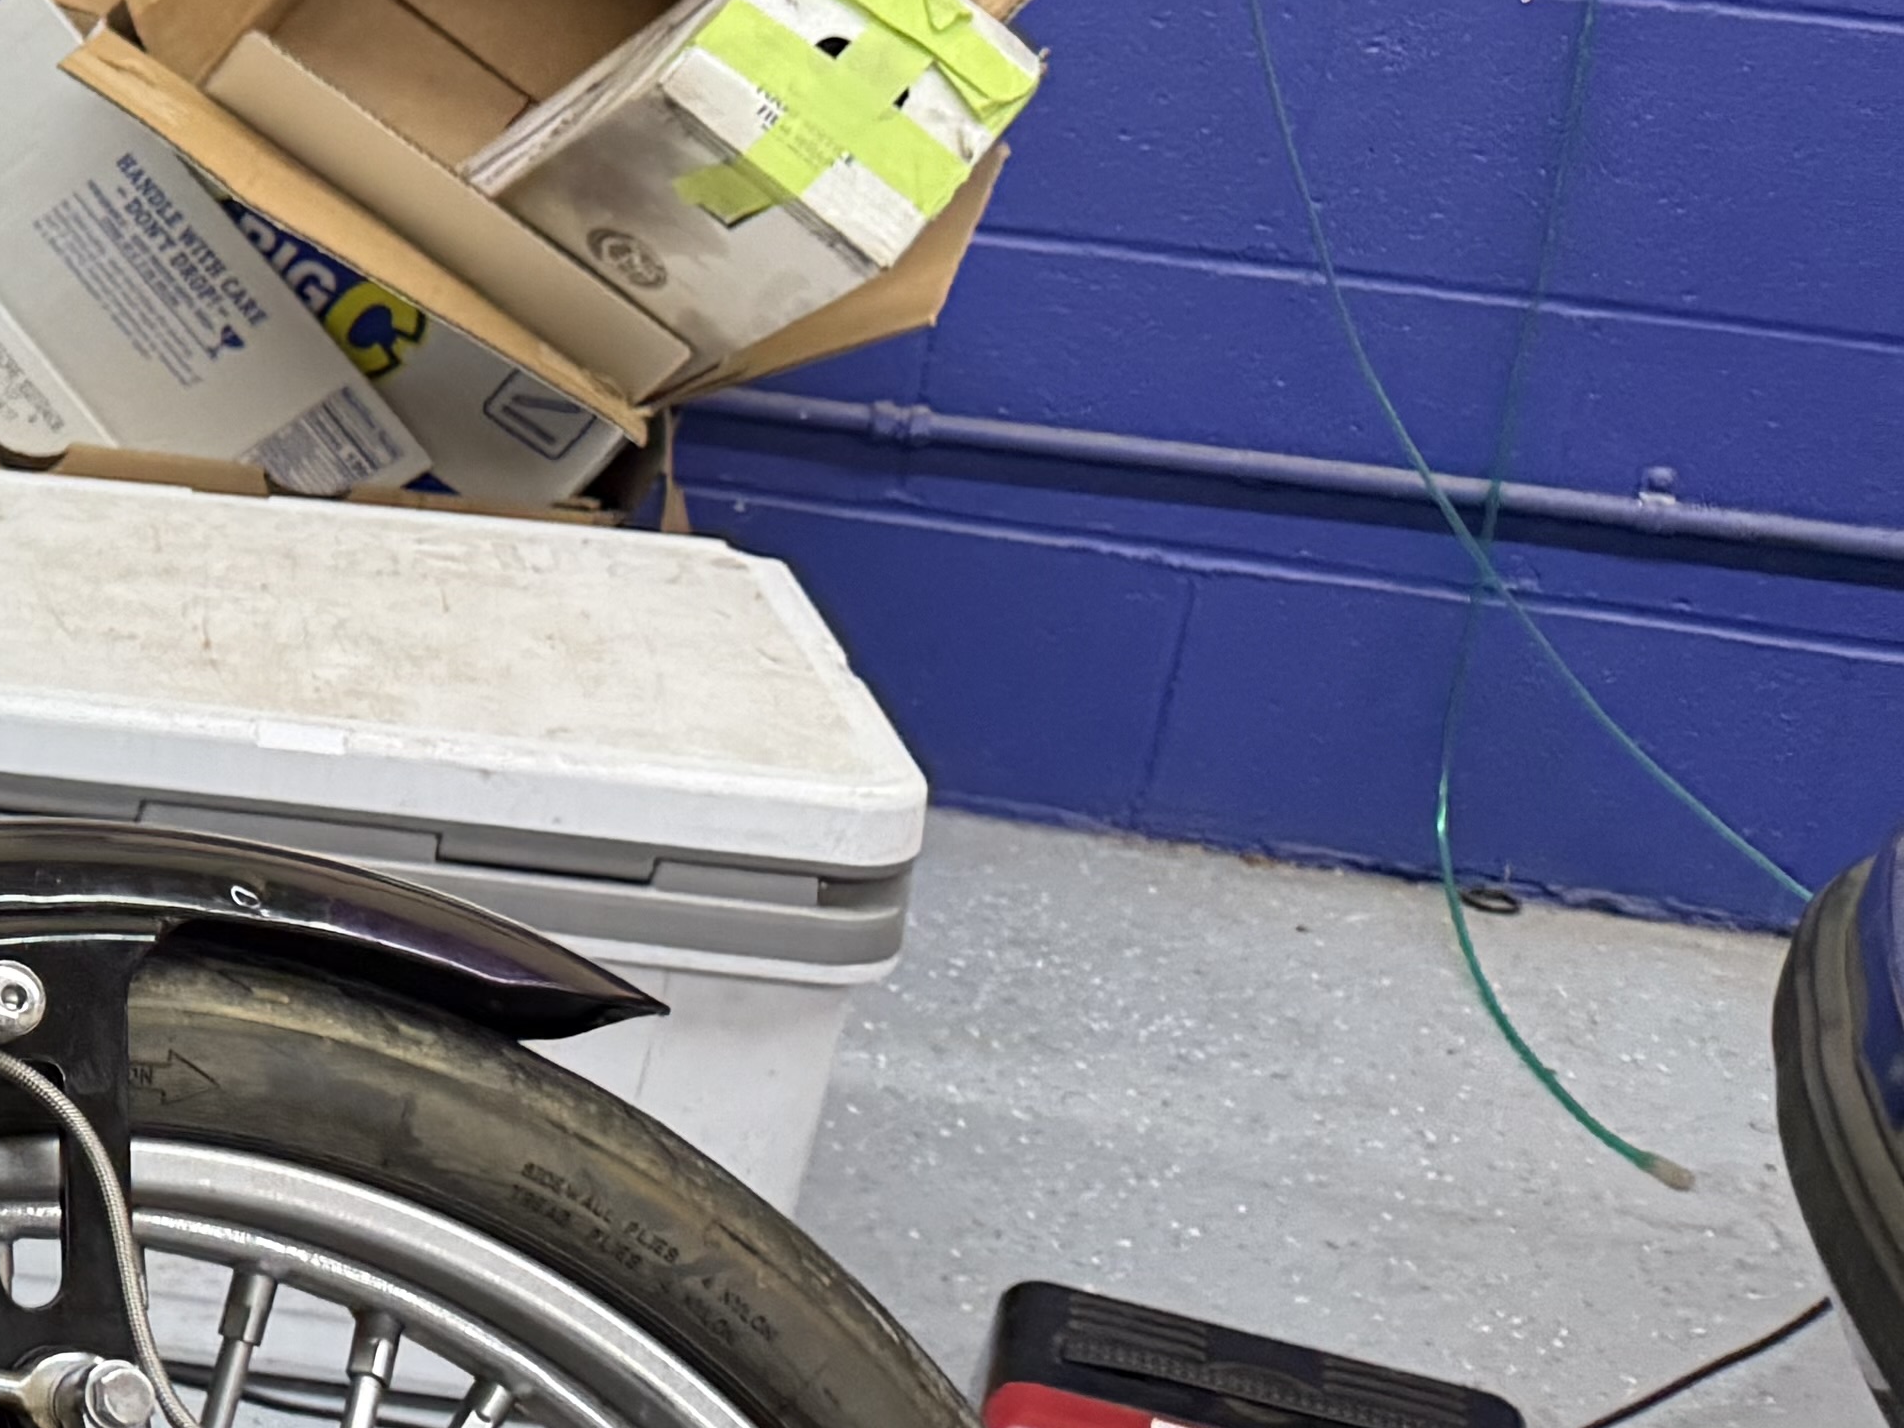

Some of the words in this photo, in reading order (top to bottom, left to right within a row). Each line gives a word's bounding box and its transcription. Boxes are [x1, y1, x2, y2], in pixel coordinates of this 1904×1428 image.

[116, 152, 183, 229] HANDLE
[179, 225, 227, 280] WITH
[218, 275, 270, 328] CARE
[124, 196, 177, 253] DON'T
[520, 1161, 612, 1223] SIDEWALL
[623, 1221, 679, 1263] PLIES
[589, 1226, 642, 1270] PLIES
